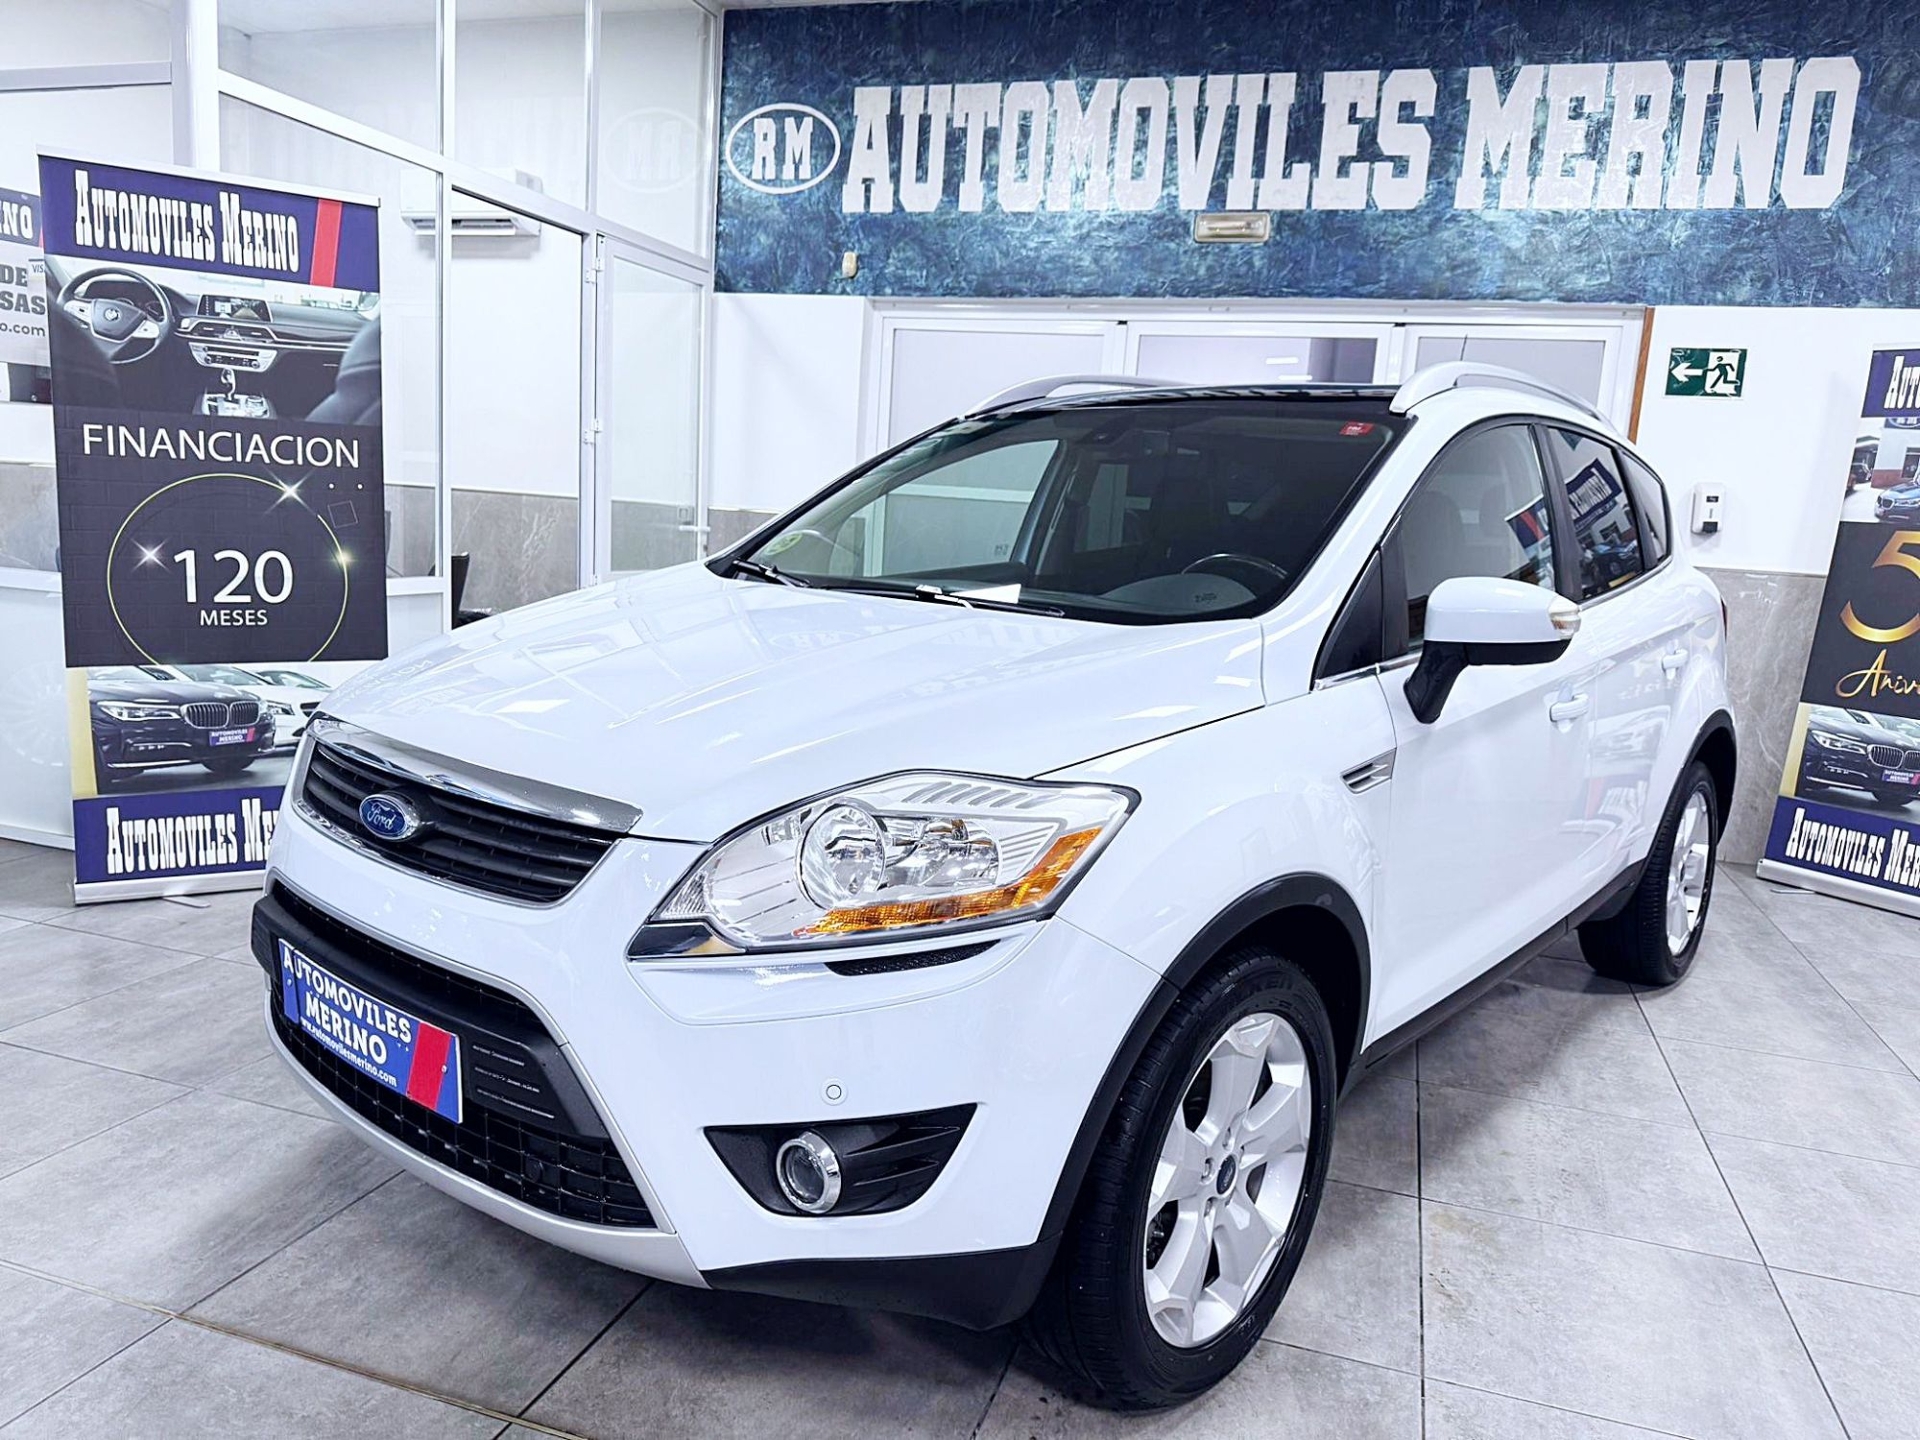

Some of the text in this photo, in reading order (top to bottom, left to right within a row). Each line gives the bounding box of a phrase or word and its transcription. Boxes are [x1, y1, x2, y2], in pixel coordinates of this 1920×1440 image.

[752, 117, 814, 180] RM
[842, 57, 1861, 213] AUTOMOVILES MERINO
[74, 169, 300, 272] AUTOMOVILES MERINO
[32, 264, 45, 273] VIS
[82, 423, 360, 468] FINANCIACION
[174, 549, 293, 604] 120
[200, 609, 268, 627] MESES
[1835, 649, 1920, 698] Aniv
[106, 798, 279, 874] AUTOMOVILES ME
[367, 802, 397, 830] Ford
[1785, 807, 1920, 888] AUTOMOVILES MER
[284, 946, 411, 1043] AUTOMOVILES
[306, 991, 387, 1064] MERINO
